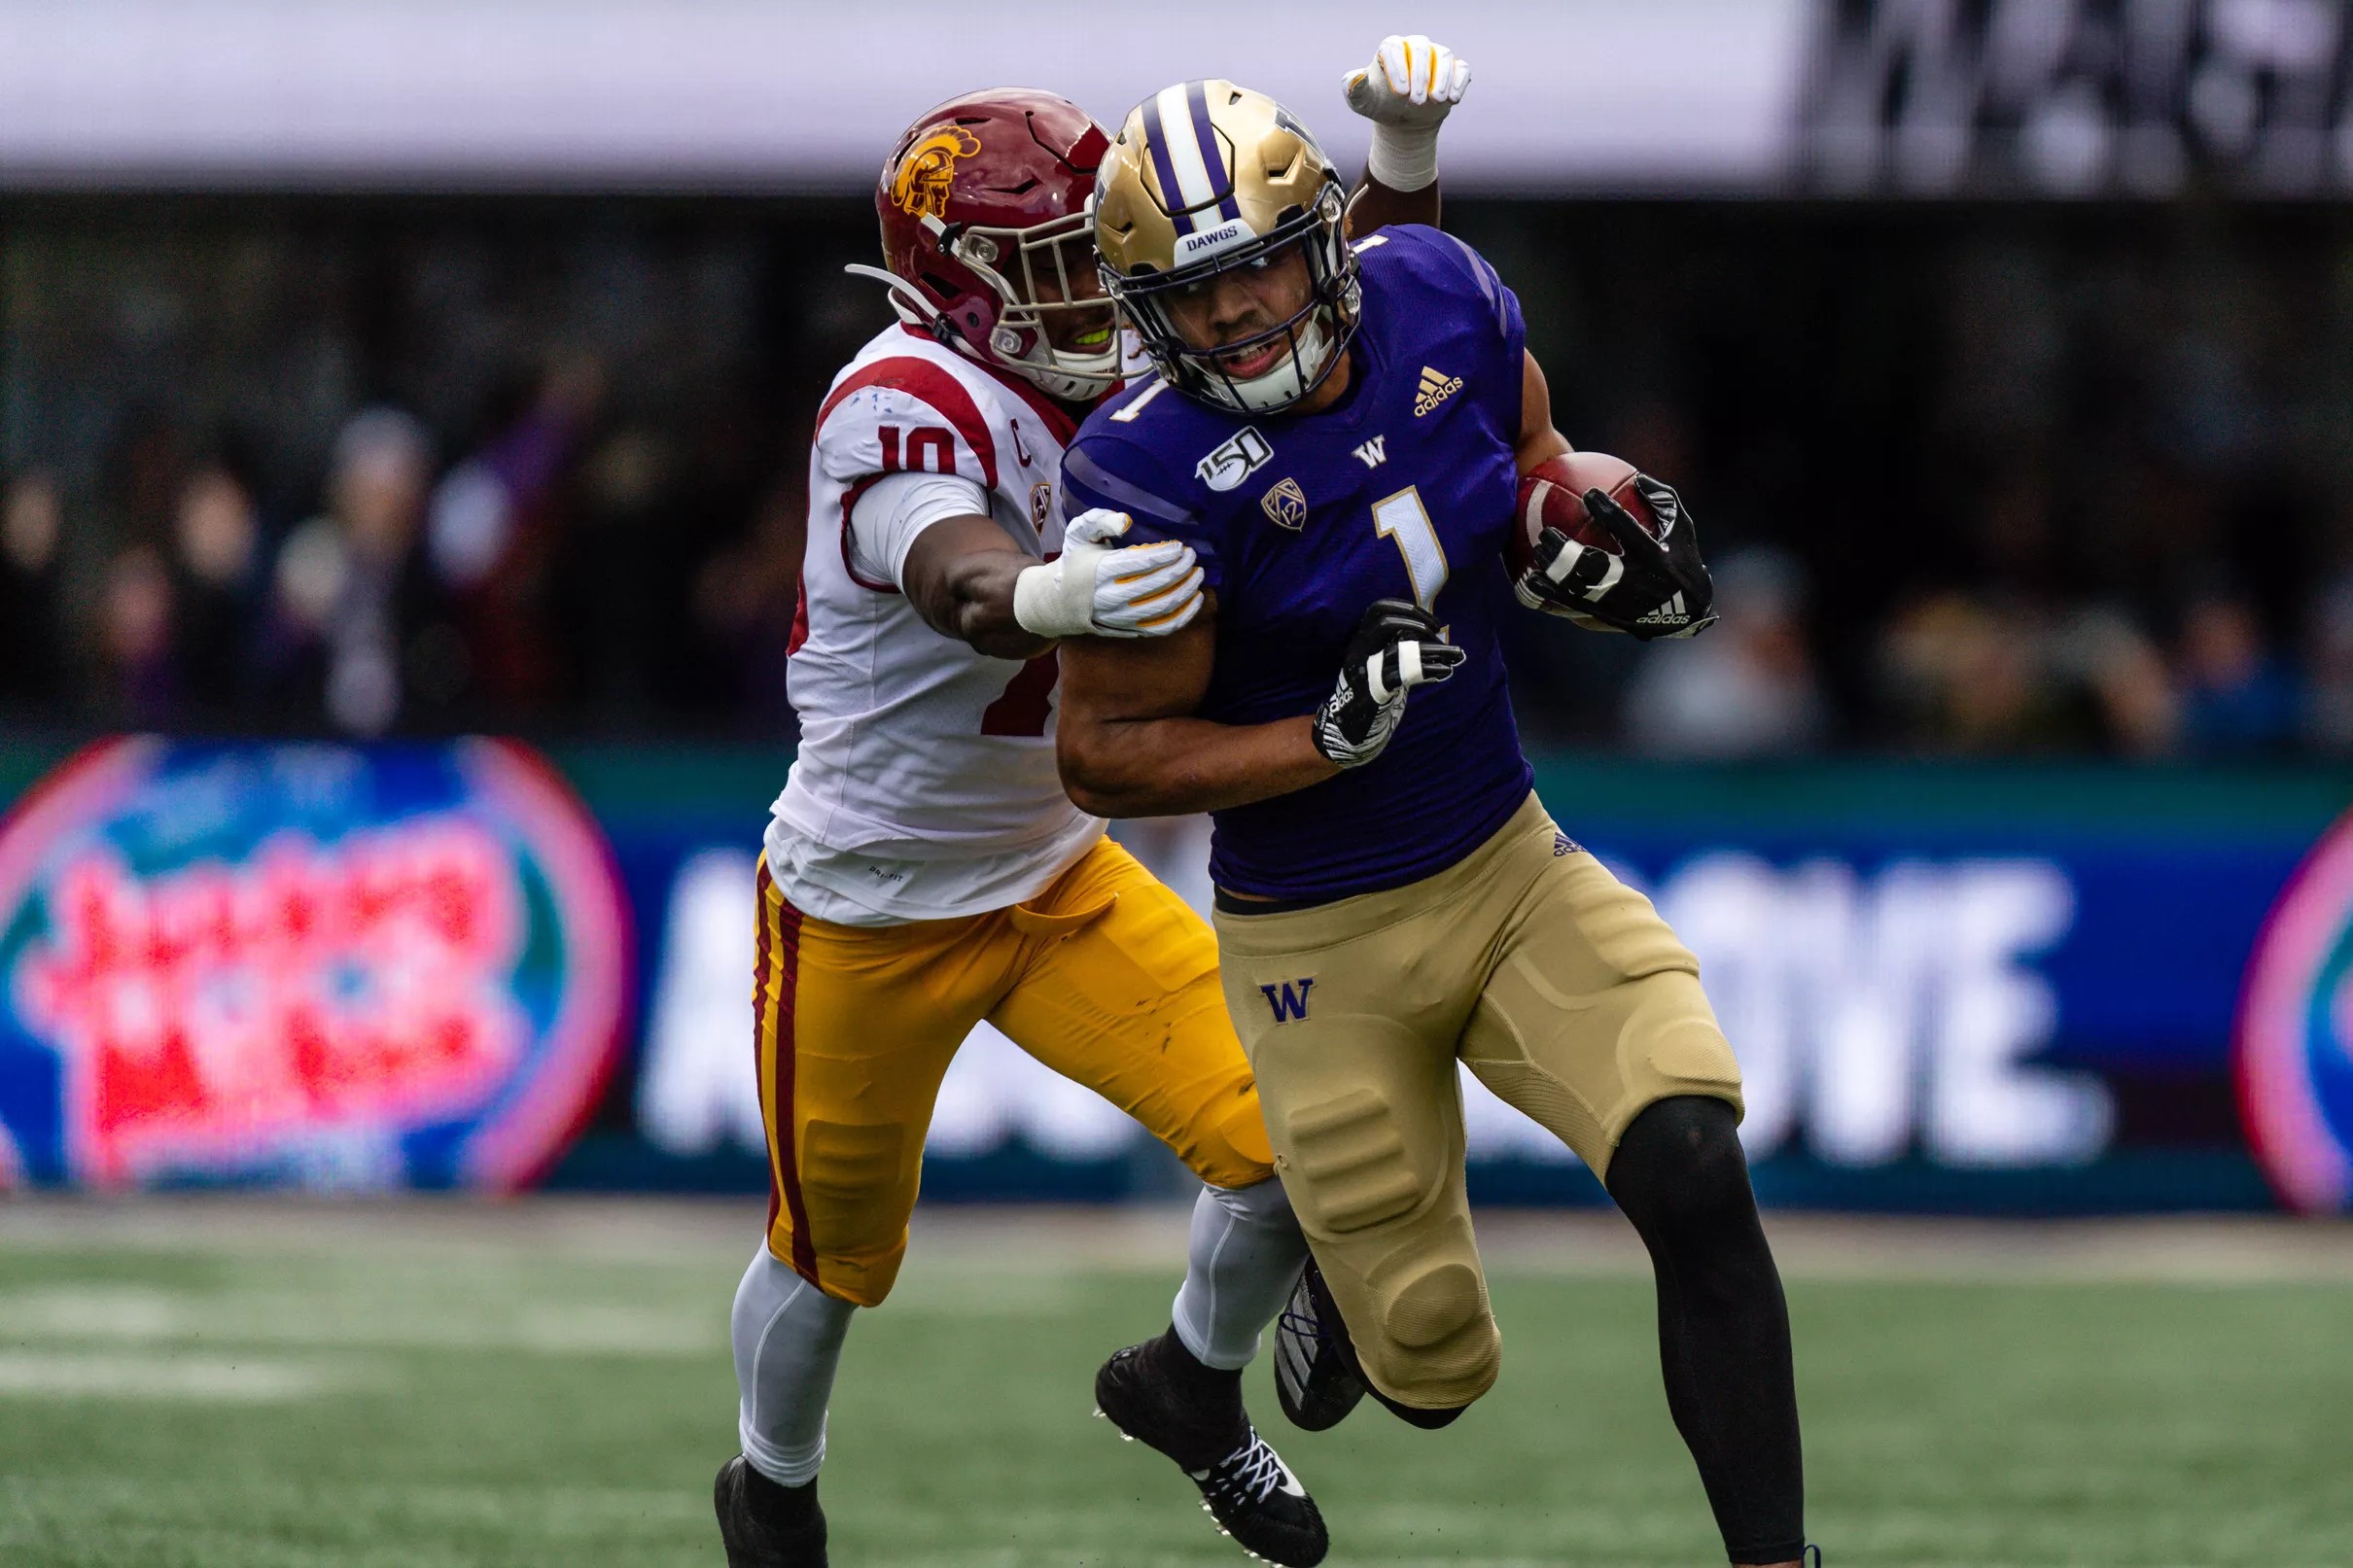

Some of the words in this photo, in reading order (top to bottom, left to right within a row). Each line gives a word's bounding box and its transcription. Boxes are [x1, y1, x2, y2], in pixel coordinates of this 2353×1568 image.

[1186, 226, 1238, 251] DAWGS
[1414, 376, 1463, 417] adidas
[878, 425, 957, 474] 10
[1200, 426, 1272, 487] 150
[1352, 434, 1387, 469] W
[1371, 484, 1449, 645] 1
[1635, 613, 1691, 624] adidas
[1259, 976, 1315, 1024] W
